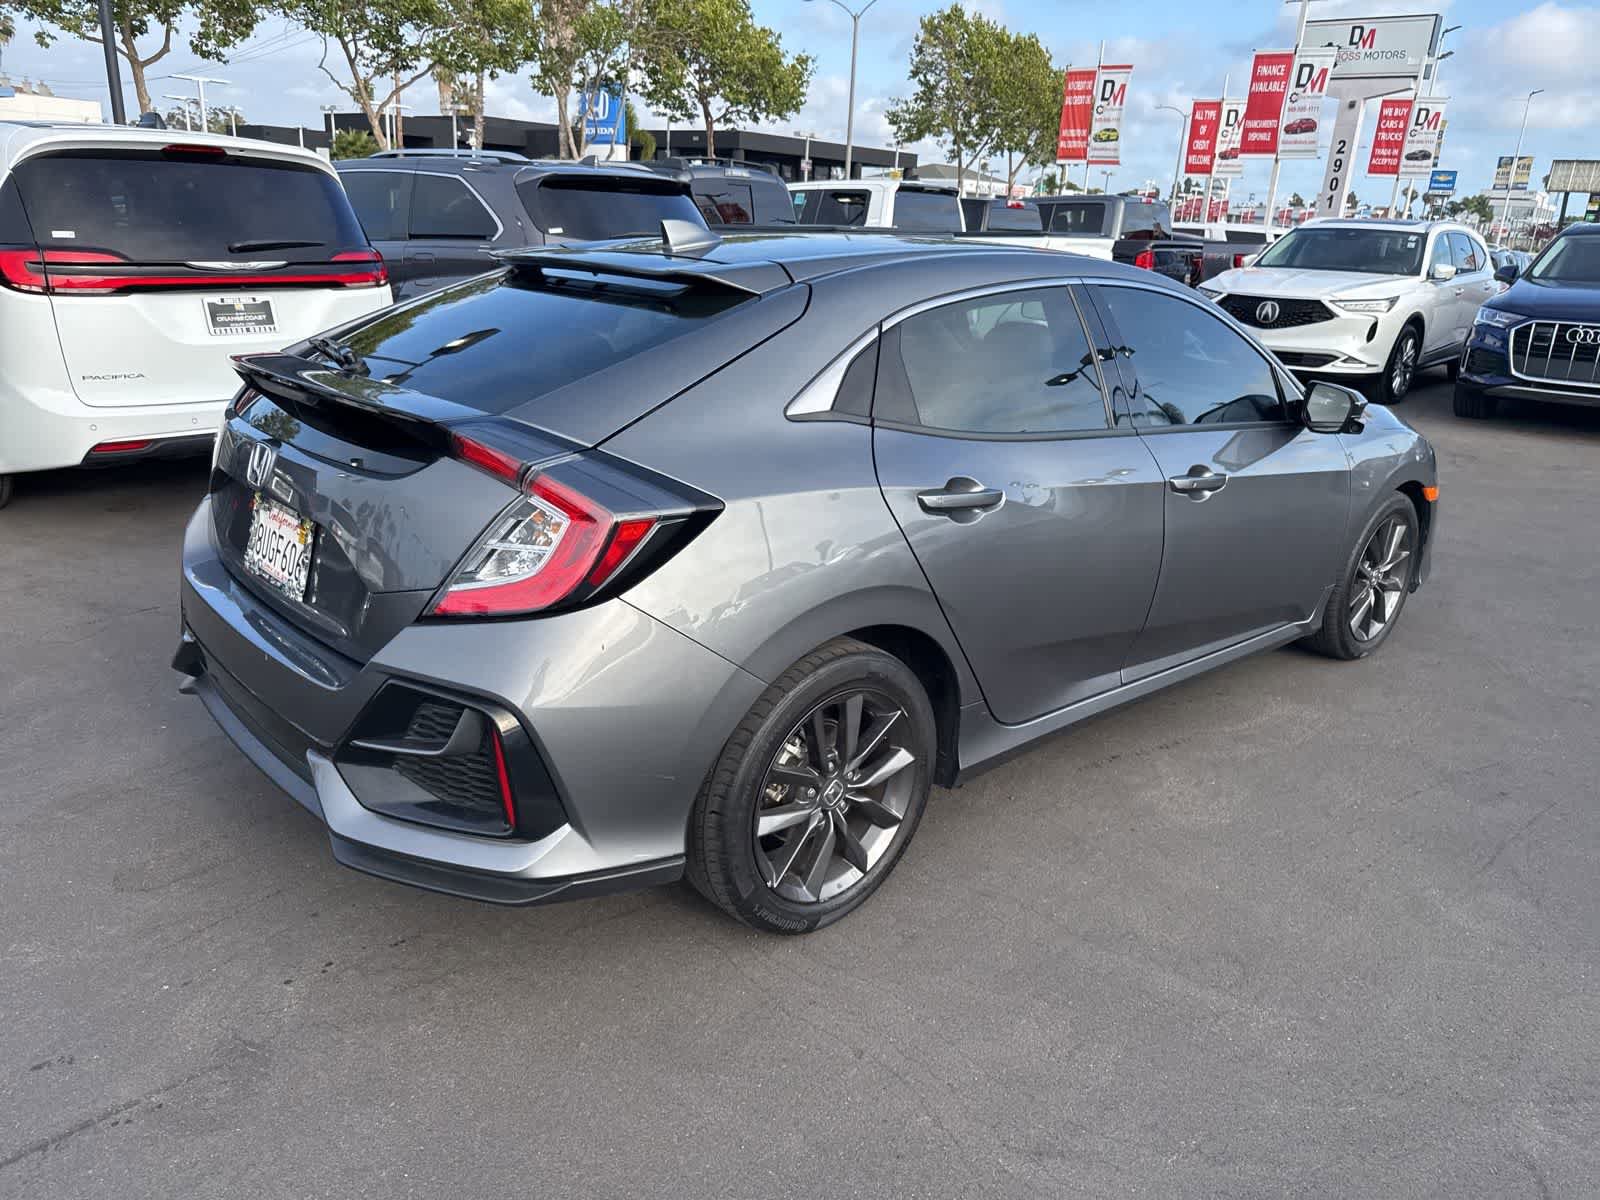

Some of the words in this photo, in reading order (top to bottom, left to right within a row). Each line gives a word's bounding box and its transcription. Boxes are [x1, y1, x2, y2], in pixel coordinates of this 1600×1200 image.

[1348, 25, 1377, 49] DM
[1363, 49, 1407, 61] MOTORS
[1256, 64, 1287, 76] FINANCE
[1295, 63, 1329, 94] DM
[1100, 79, 1127, 106] DM
[1250, 81, 1286, 93] AVAILABLE
[1382, 108, 1394, 117] WE
[1393, 107, 1409, 117] BUY
[1380, 120, 1399, 129] CARS
[1414, 108, 1442, 131] DM
[1376, 132, 1403, 141] TRUCKS
[1371, 158, 1398, 166] ACCEPTED
[1326, 139, 1347, 209] 2901
[81, 373, 145, 381] PACIFICA
